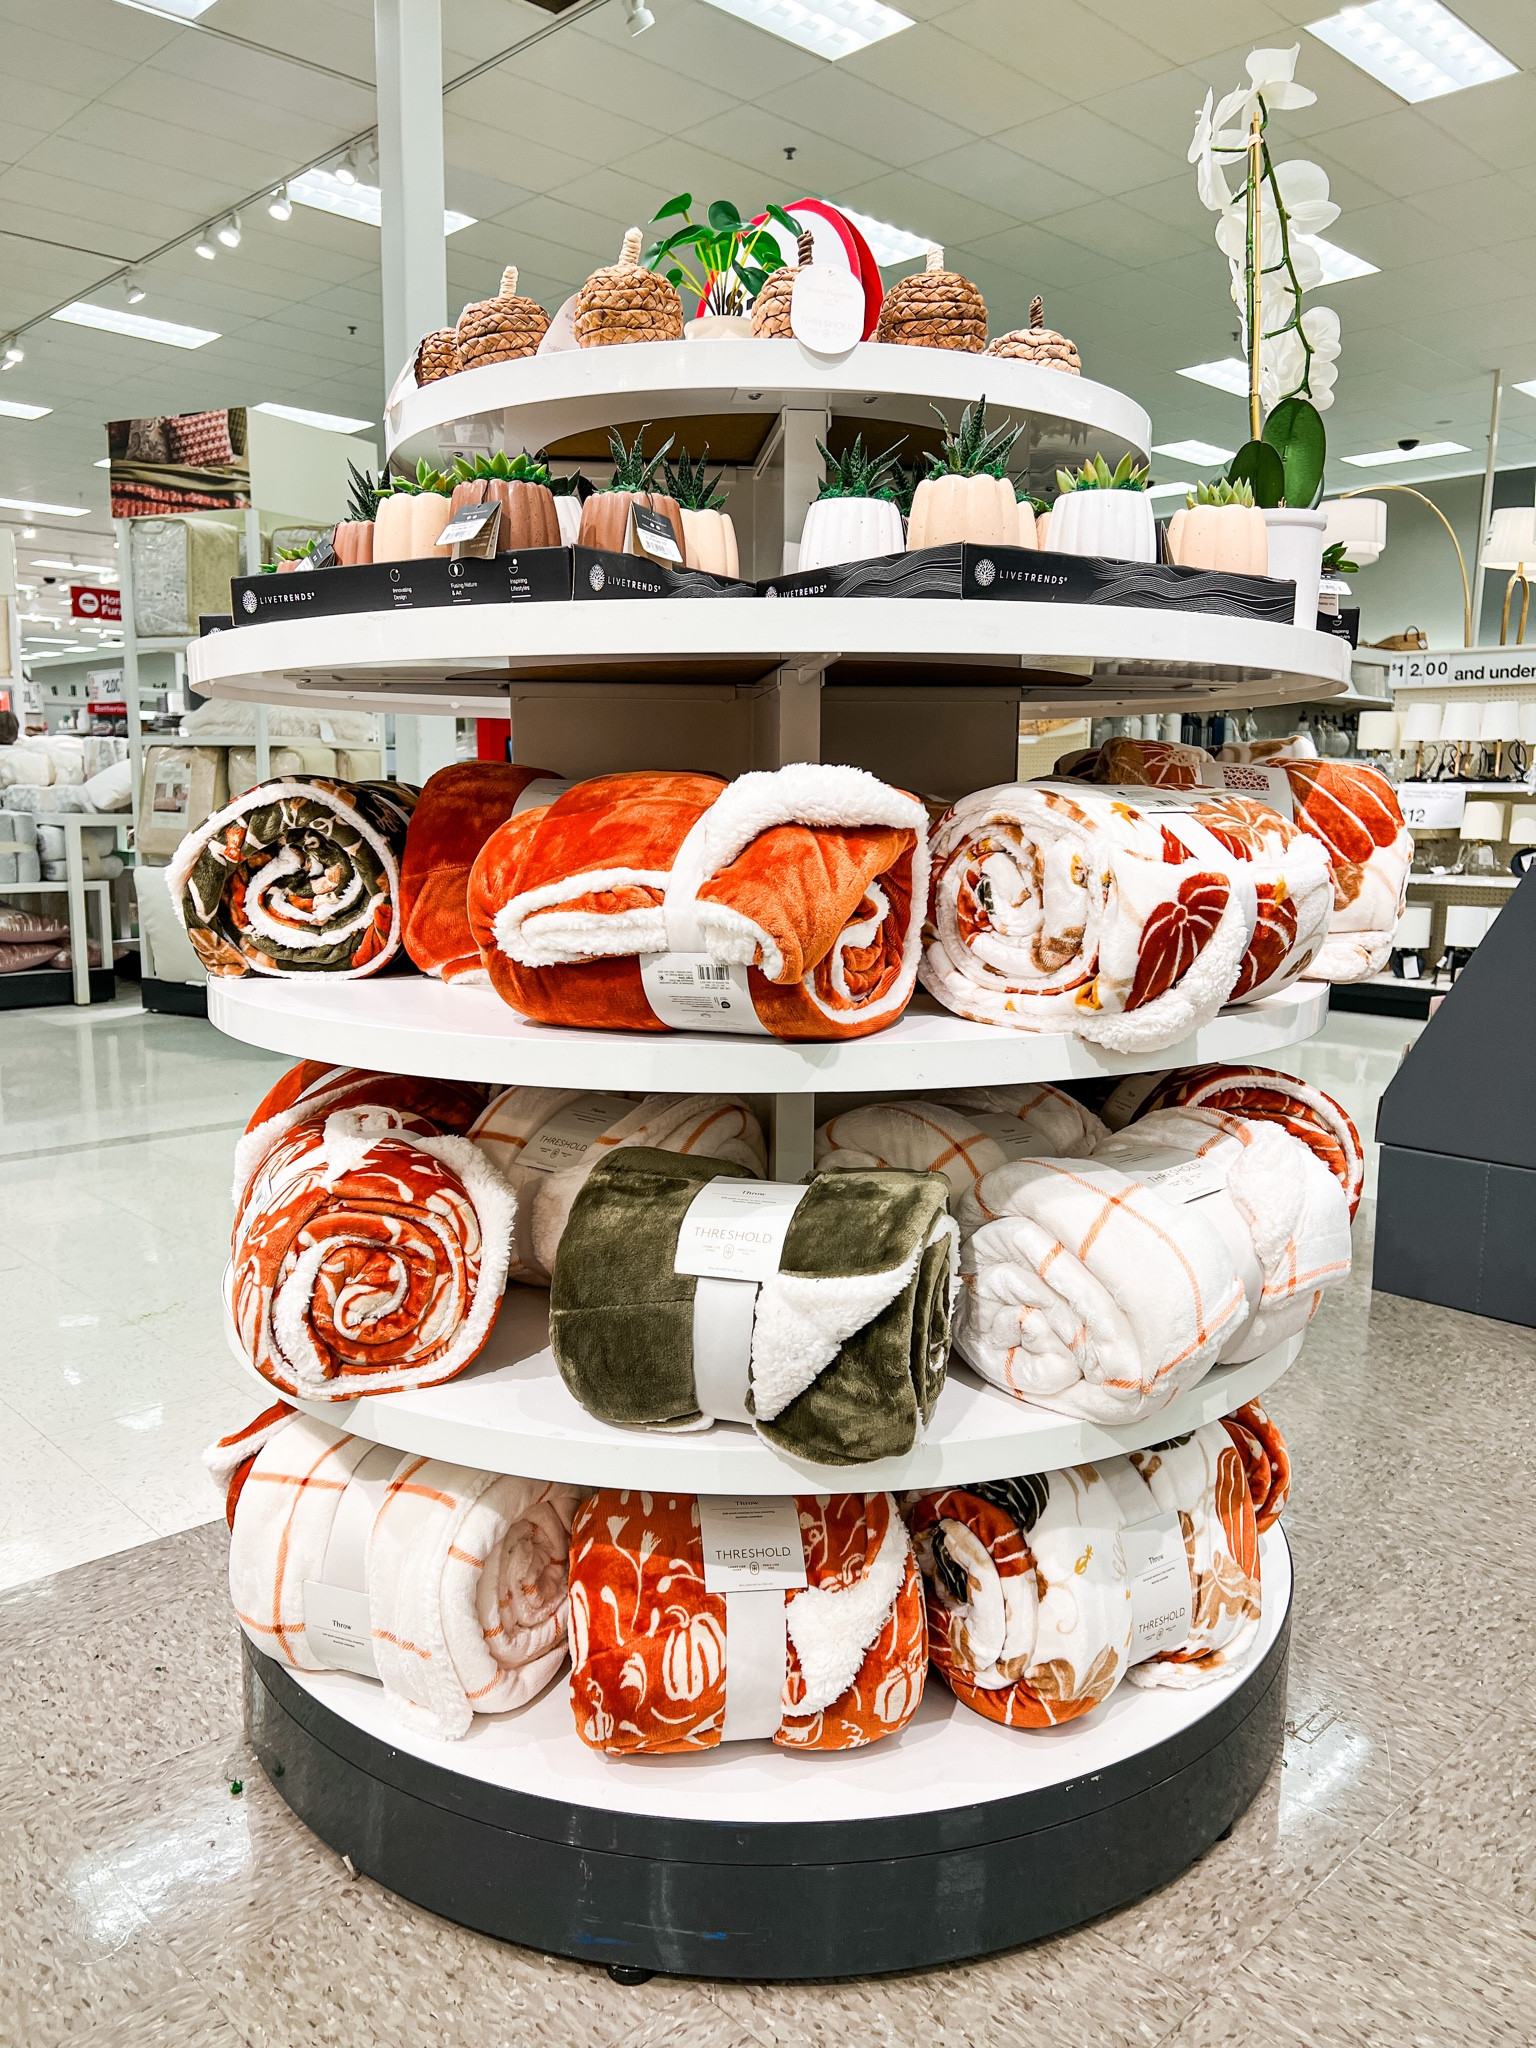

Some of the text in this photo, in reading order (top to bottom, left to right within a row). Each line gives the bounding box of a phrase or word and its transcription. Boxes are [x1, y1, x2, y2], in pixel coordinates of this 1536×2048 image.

[1454, 665, 1485, 680] and
[1489, 664, 1536, 679] under
[539, 1135, 588, 1152] THRESHOLD
[1147, 1162, 1201, 1183] THRESHOLD
[694, 1226, 773, 1244] THRESHOLD
[715, 1546, 791, 1560] THRESHOLD
[1148, 1553, 1164, 1564] Throw
[332, 1619, 353, 1630] Throw
[1139, 1607, 1186, 1634] THRESHOLD
